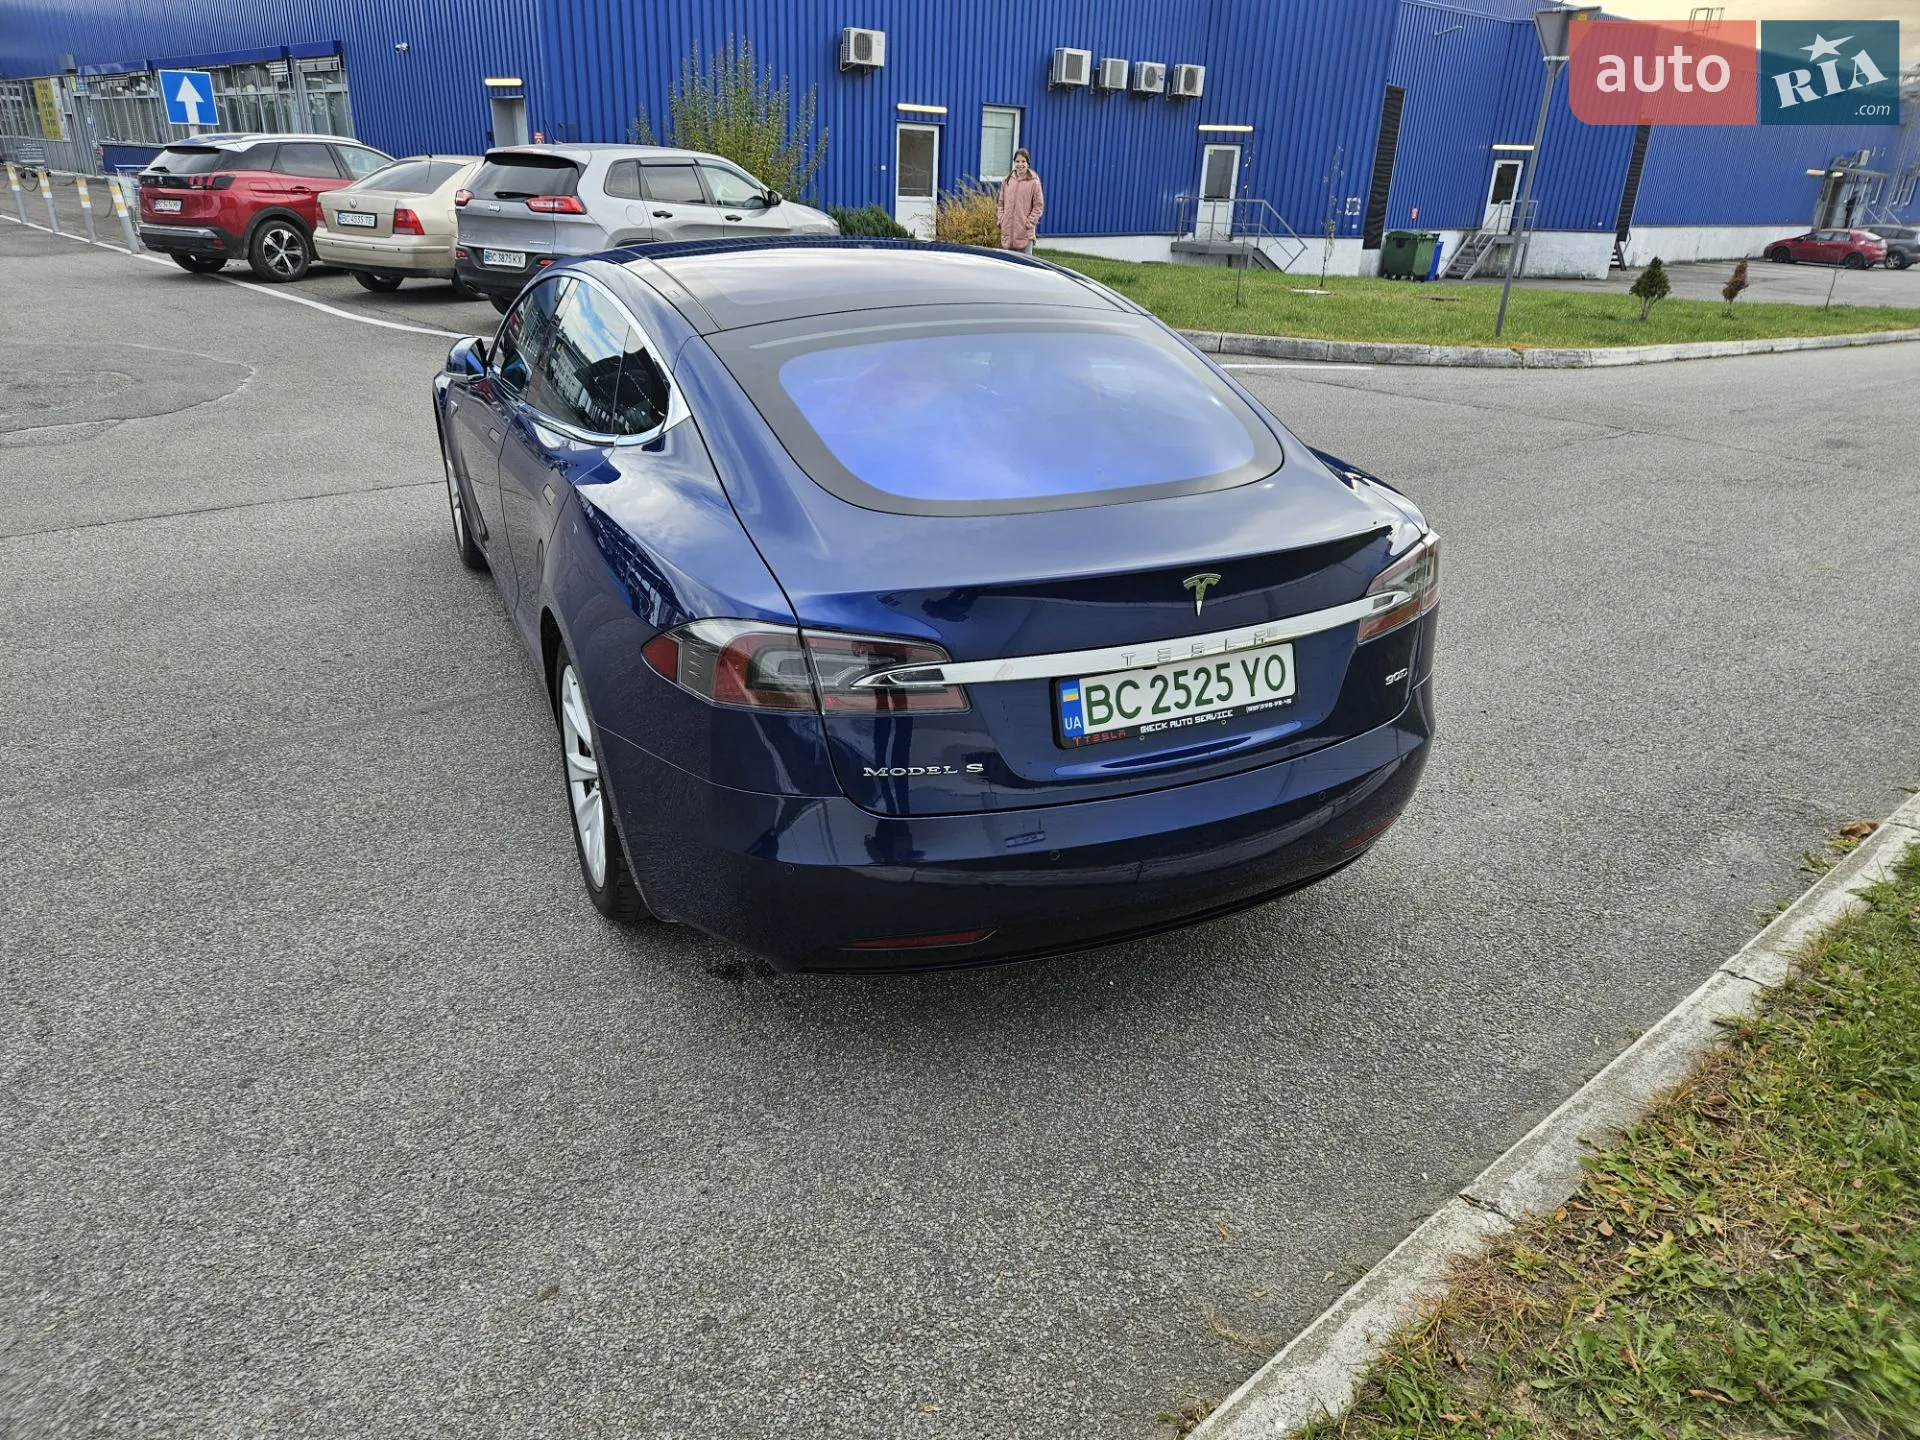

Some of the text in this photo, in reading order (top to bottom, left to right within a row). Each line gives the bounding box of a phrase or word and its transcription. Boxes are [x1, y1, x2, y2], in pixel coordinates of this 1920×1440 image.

[1121, 631, 1267, 666] TESLA
[1085, 654, 1287, 727] BC 2525 YO
[1065, 715, 1083, 730] UA
[1169, 717, 1193, 729] AUTO
[1194, 709, 1234, 724] SERVICE
[863, 763, 984, 777] MODEL S
